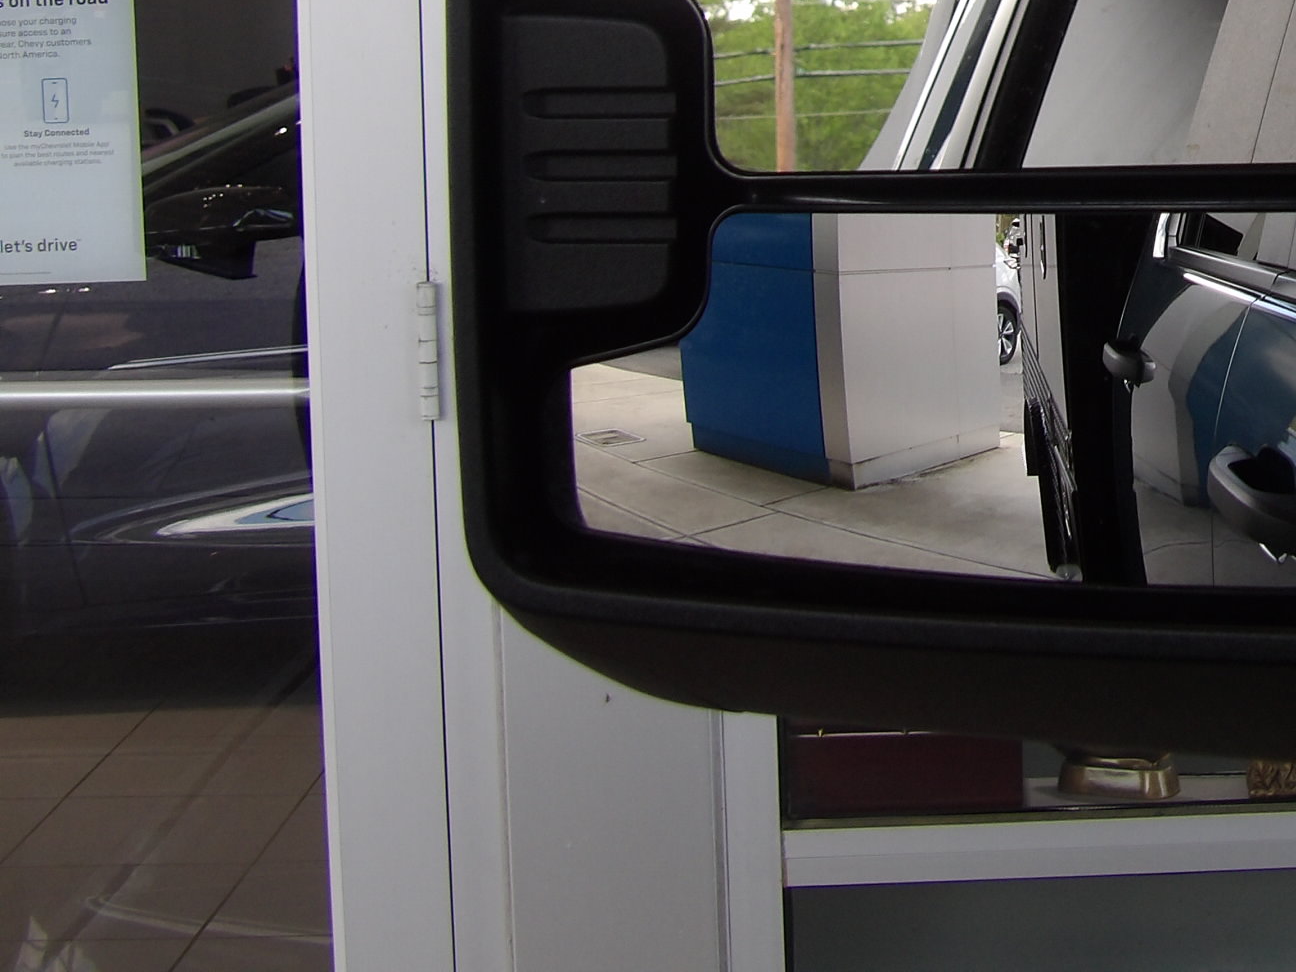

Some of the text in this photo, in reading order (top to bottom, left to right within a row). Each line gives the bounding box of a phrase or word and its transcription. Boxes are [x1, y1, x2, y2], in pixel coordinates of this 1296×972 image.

[39, 17, 77, 25] charging
[50, 28, 59, 36] to
[18, 40, 44, 48] Chevy
[46, 38, 92, 47] customers
[24, 128, 90, 138] Stay Connected
[0, 238, 78, 253] let's drive
